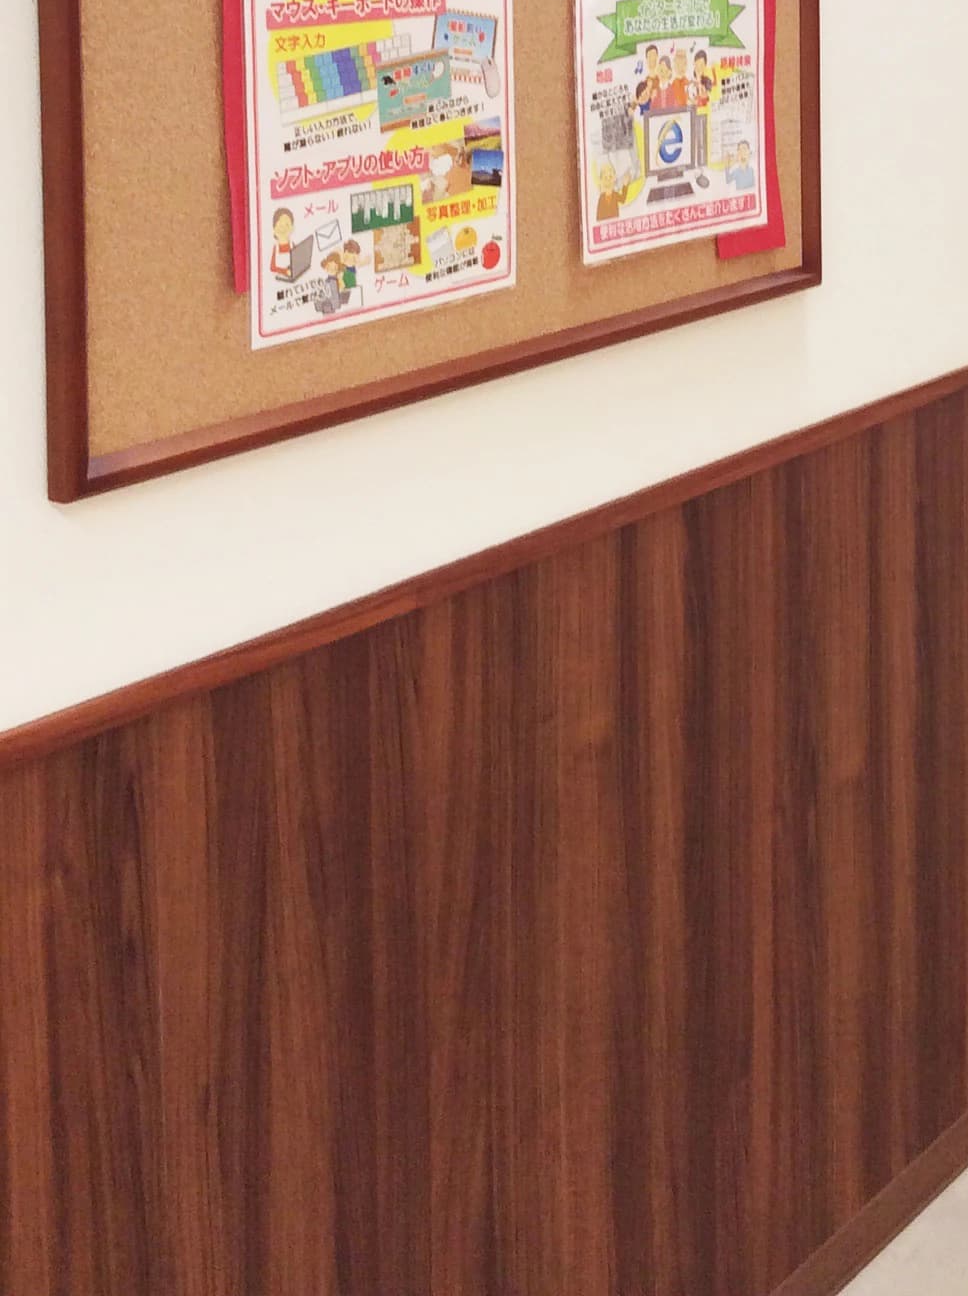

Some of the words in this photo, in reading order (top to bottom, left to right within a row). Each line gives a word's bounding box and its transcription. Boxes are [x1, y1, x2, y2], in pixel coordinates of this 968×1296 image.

[274, 33, 326, 52] 文字入力
[273, 148, 425, 192] ソフト・アプリの使い方
